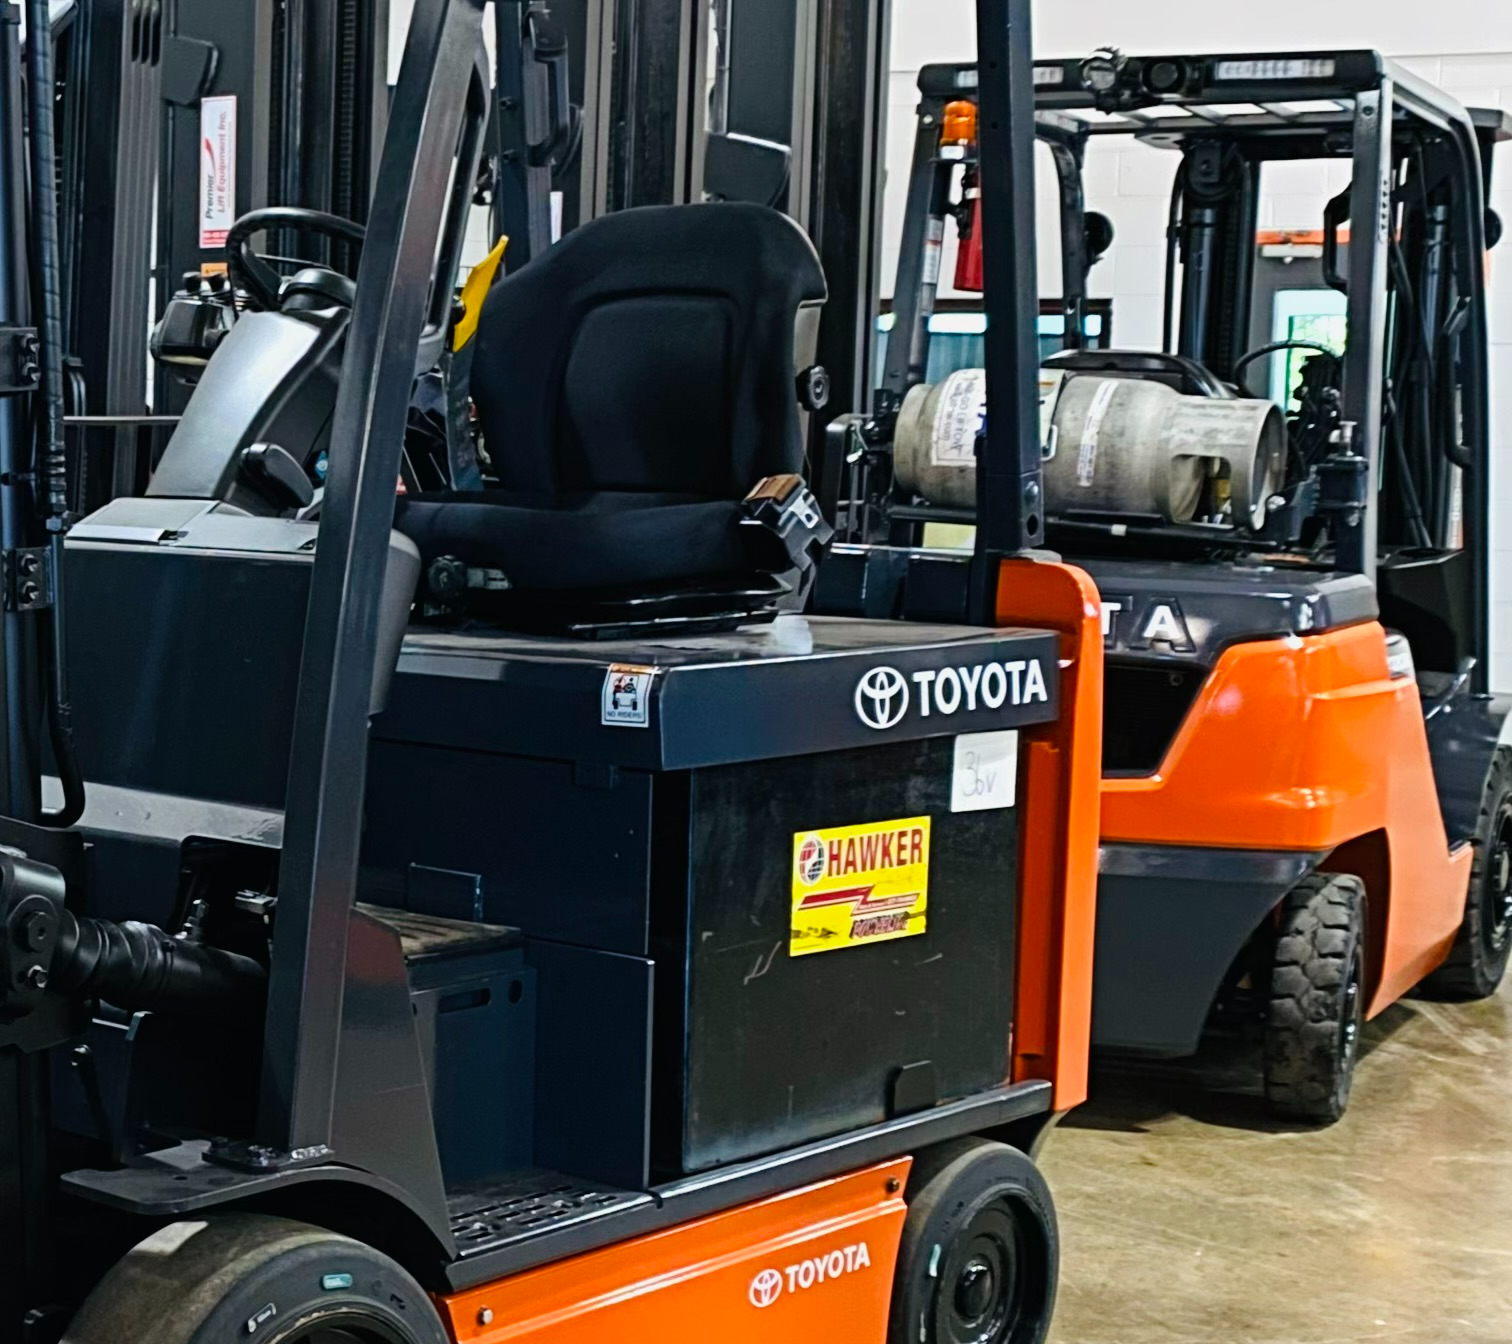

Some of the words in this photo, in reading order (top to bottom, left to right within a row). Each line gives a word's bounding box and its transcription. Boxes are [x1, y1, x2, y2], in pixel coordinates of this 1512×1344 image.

[204, 174, 215, 220] Premier
[912, 658, 1049, 717] TOYOTA
[827, 827, 924, 878] HAWKER
[784, 1241, 872, 1294] TOYOTA
